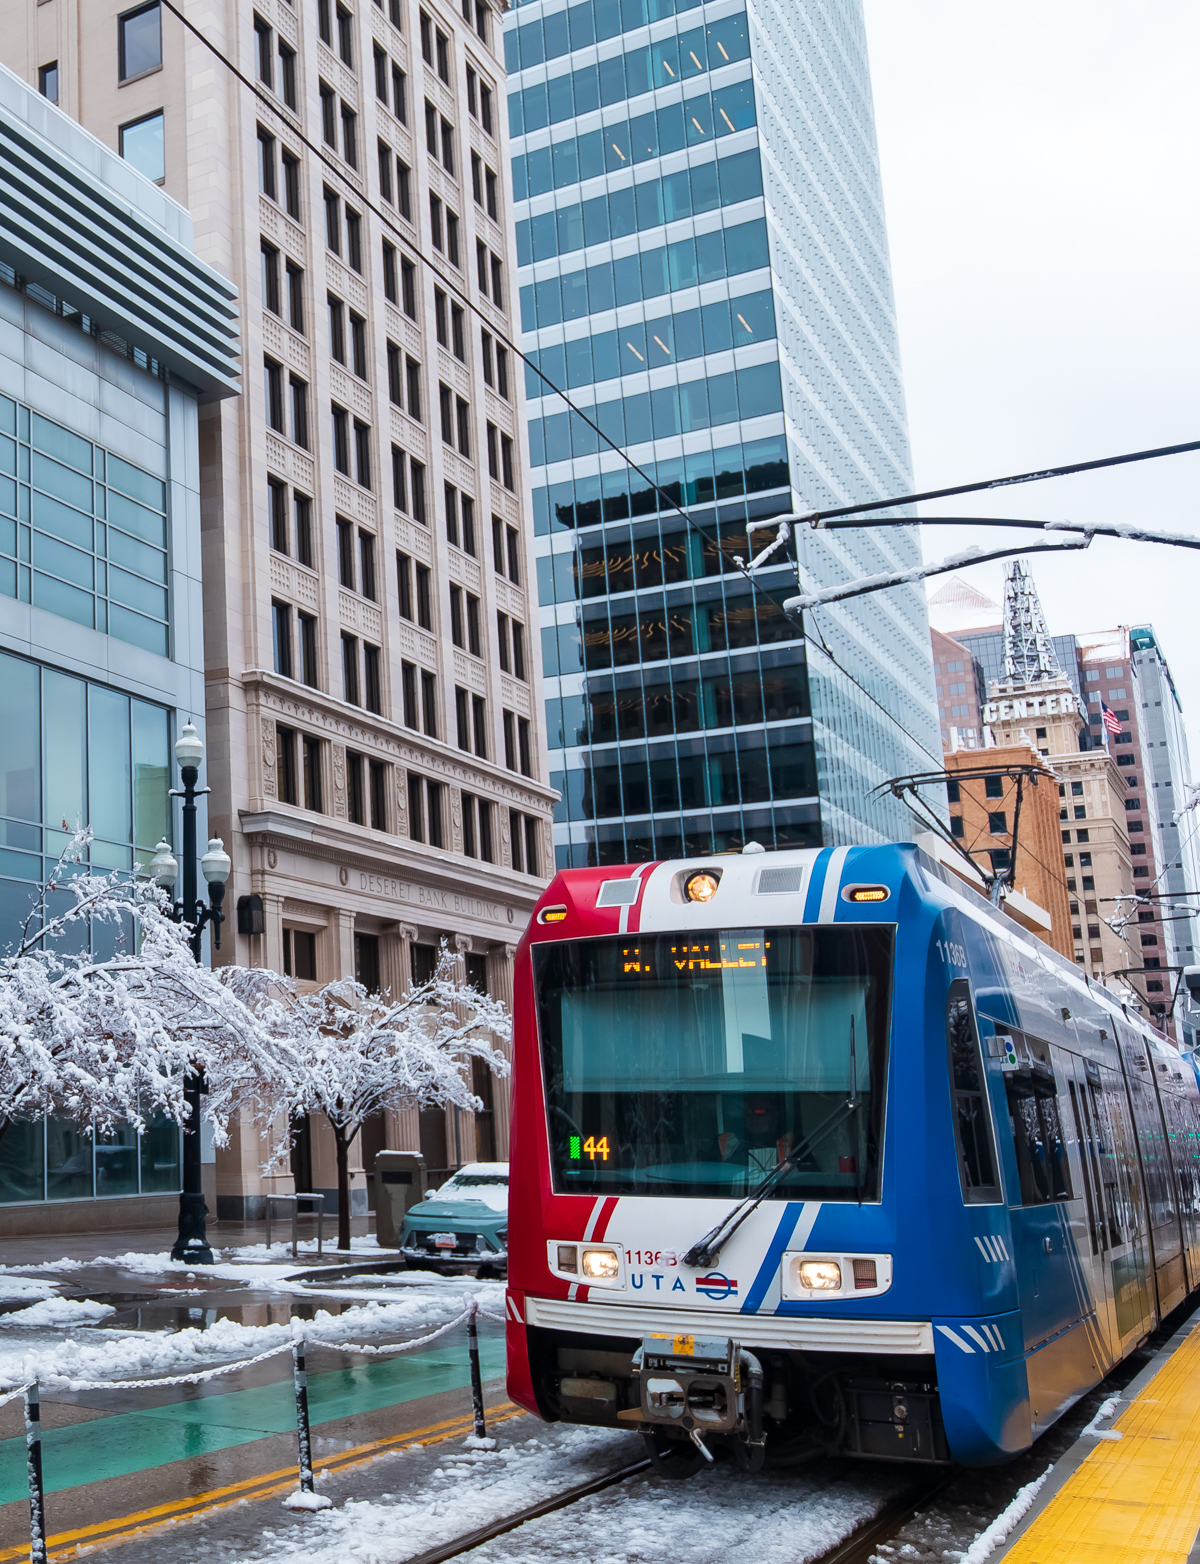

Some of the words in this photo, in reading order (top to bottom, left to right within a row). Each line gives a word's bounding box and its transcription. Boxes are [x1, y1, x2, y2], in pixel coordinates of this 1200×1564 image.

[1018, 559, 1051, 672] WALKER
[984, 693, 1075, 723] CENTER
[360, 873, 411, 900] DESERET
[419, 887, 448, 909] BANK
[454, 895, 499, 920] BUILDING
[623, 948, 650, 972] W.
[936, 939, 967, 968] 1136B
[583, 1136, 610, 1160] 44
[631, 1273, 686, 1292] UTA
